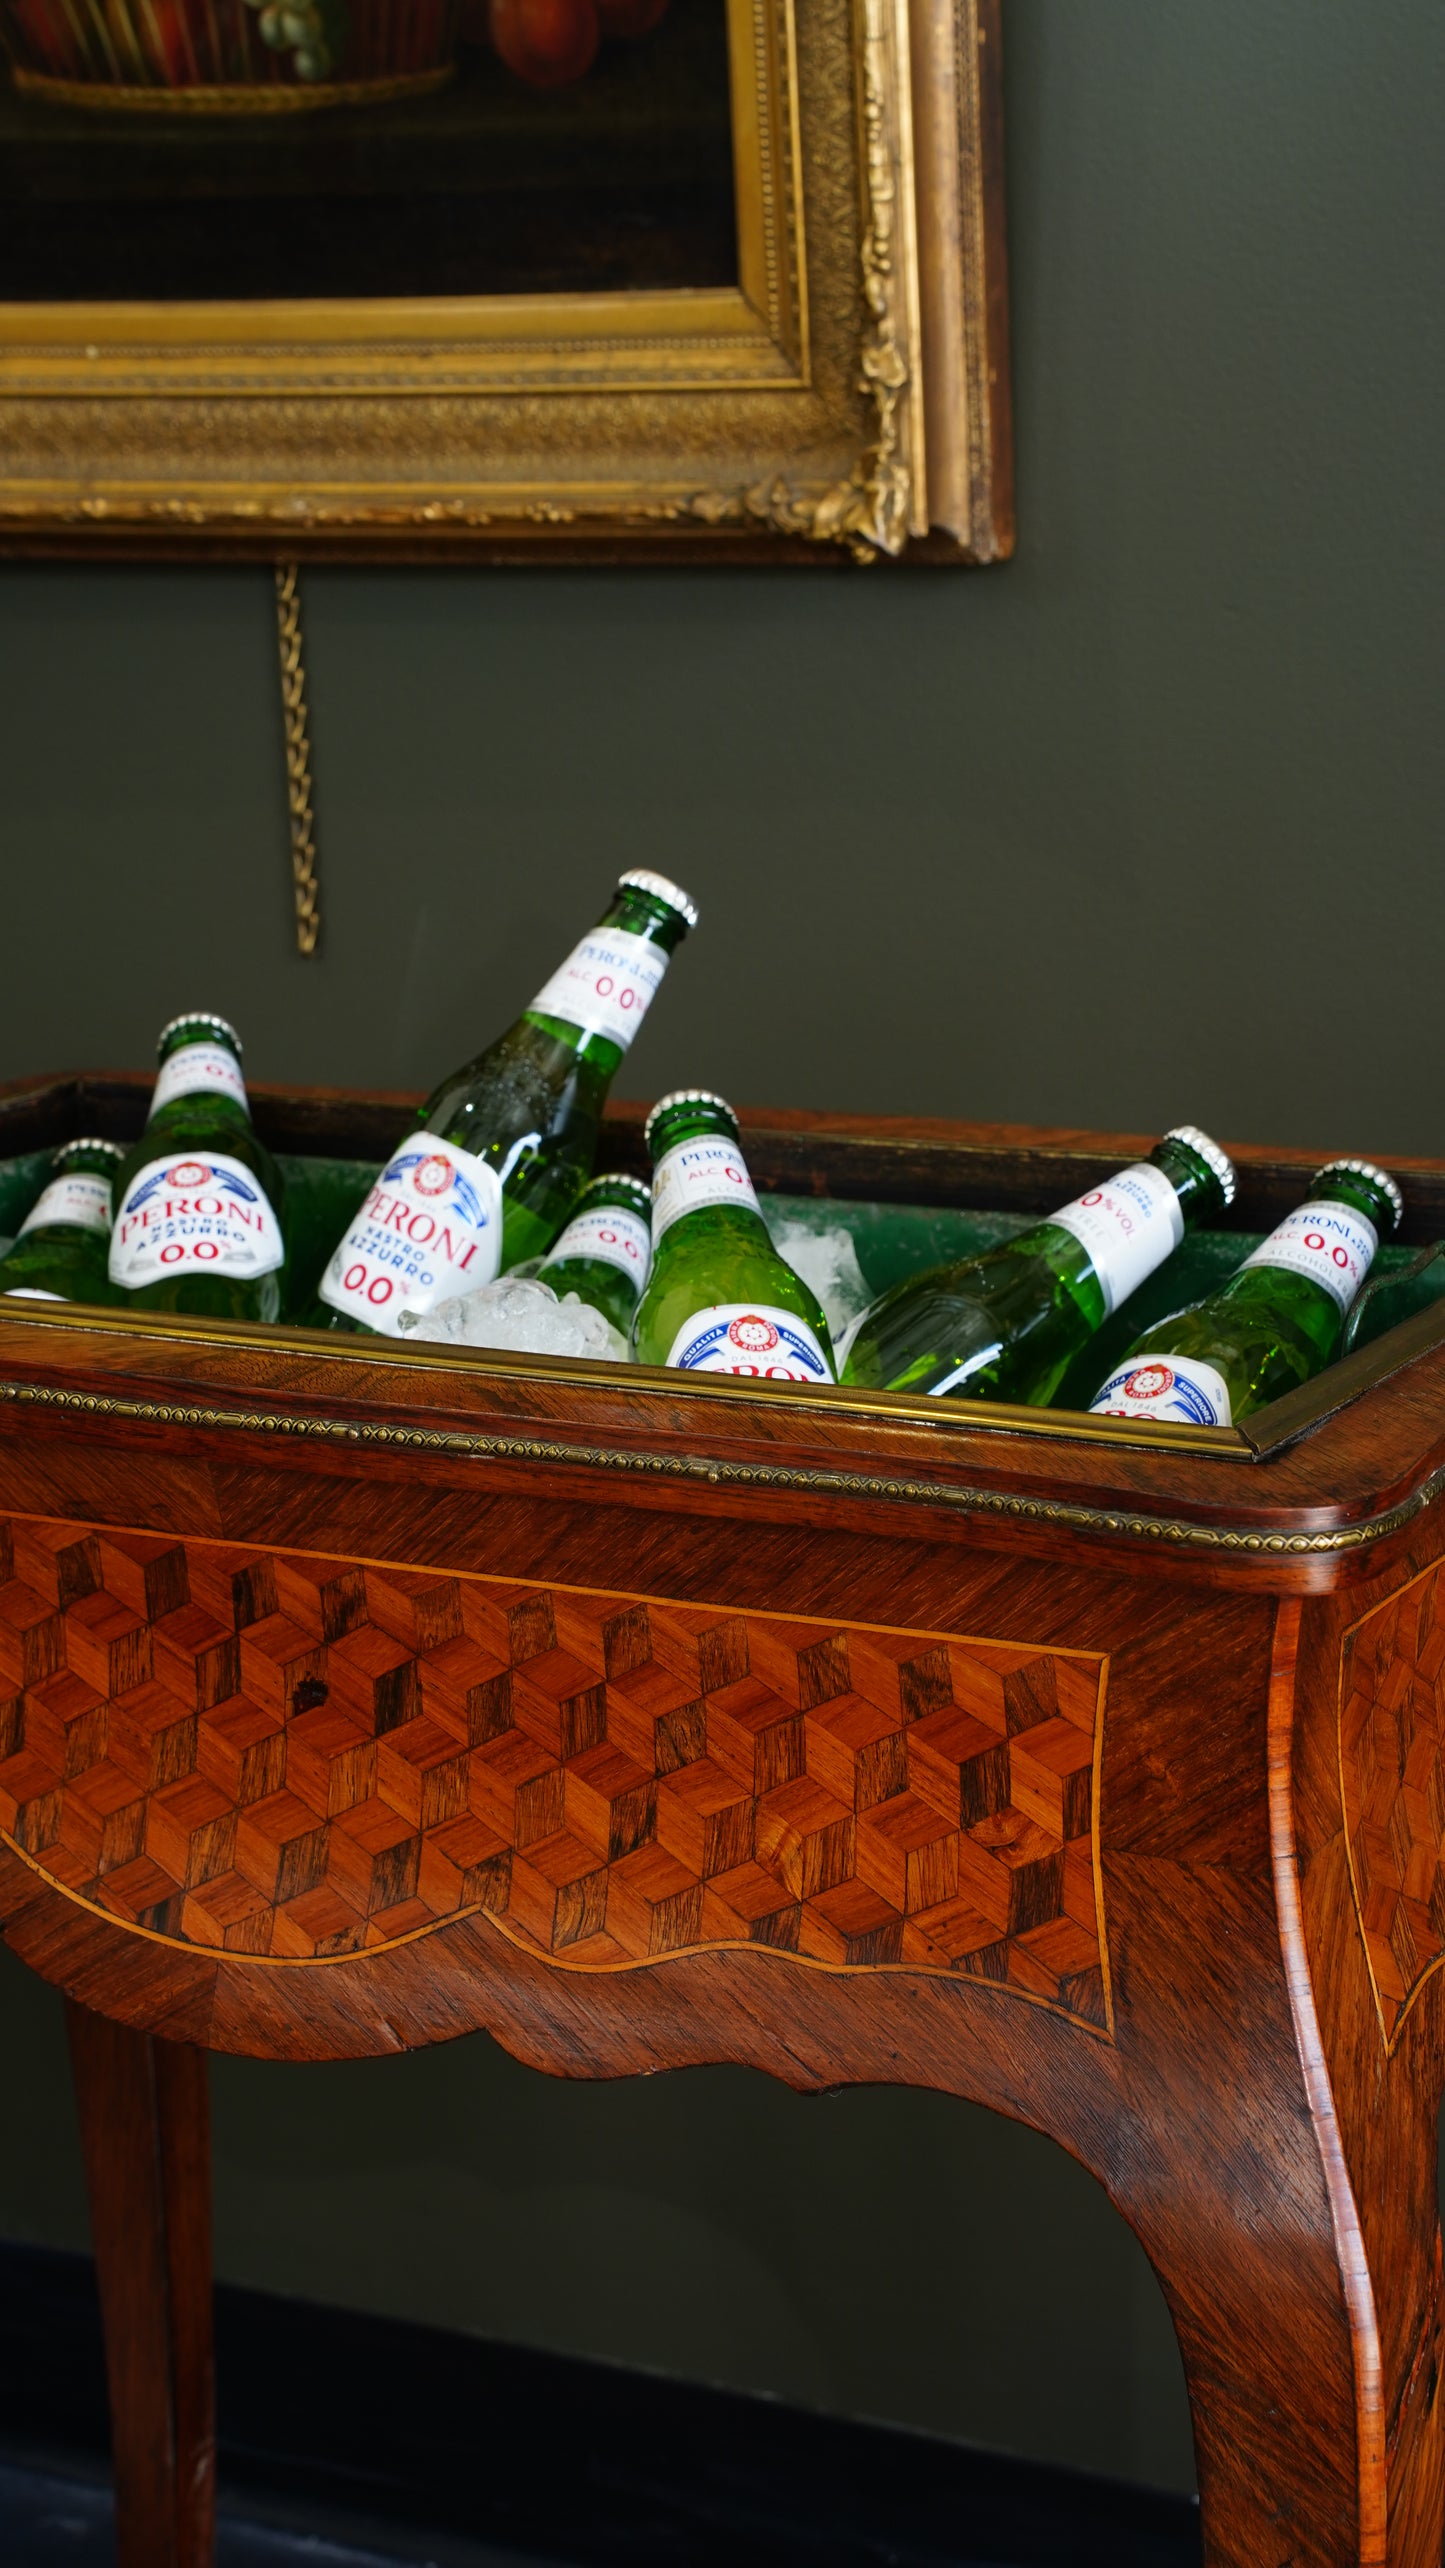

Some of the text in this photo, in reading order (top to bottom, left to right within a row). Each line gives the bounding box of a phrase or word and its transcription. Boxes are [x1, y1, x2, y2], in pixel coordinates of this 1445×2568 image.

[121, 1196, 264, 1246] PERONI
[136, 1225, 246, 1252] AZZURRO
[152, 1217, 228, 1232] NASTRO
[359, 1186, 478, 1270] PERONI
[349, 1234, 434, 1286] AZZURRO
[366, 1225, 425, 1261] NASTRO
[782, 1331, 823, 1371] SUPERIORE
[1178, 1381, 1212, 1422] SUPERIORE
